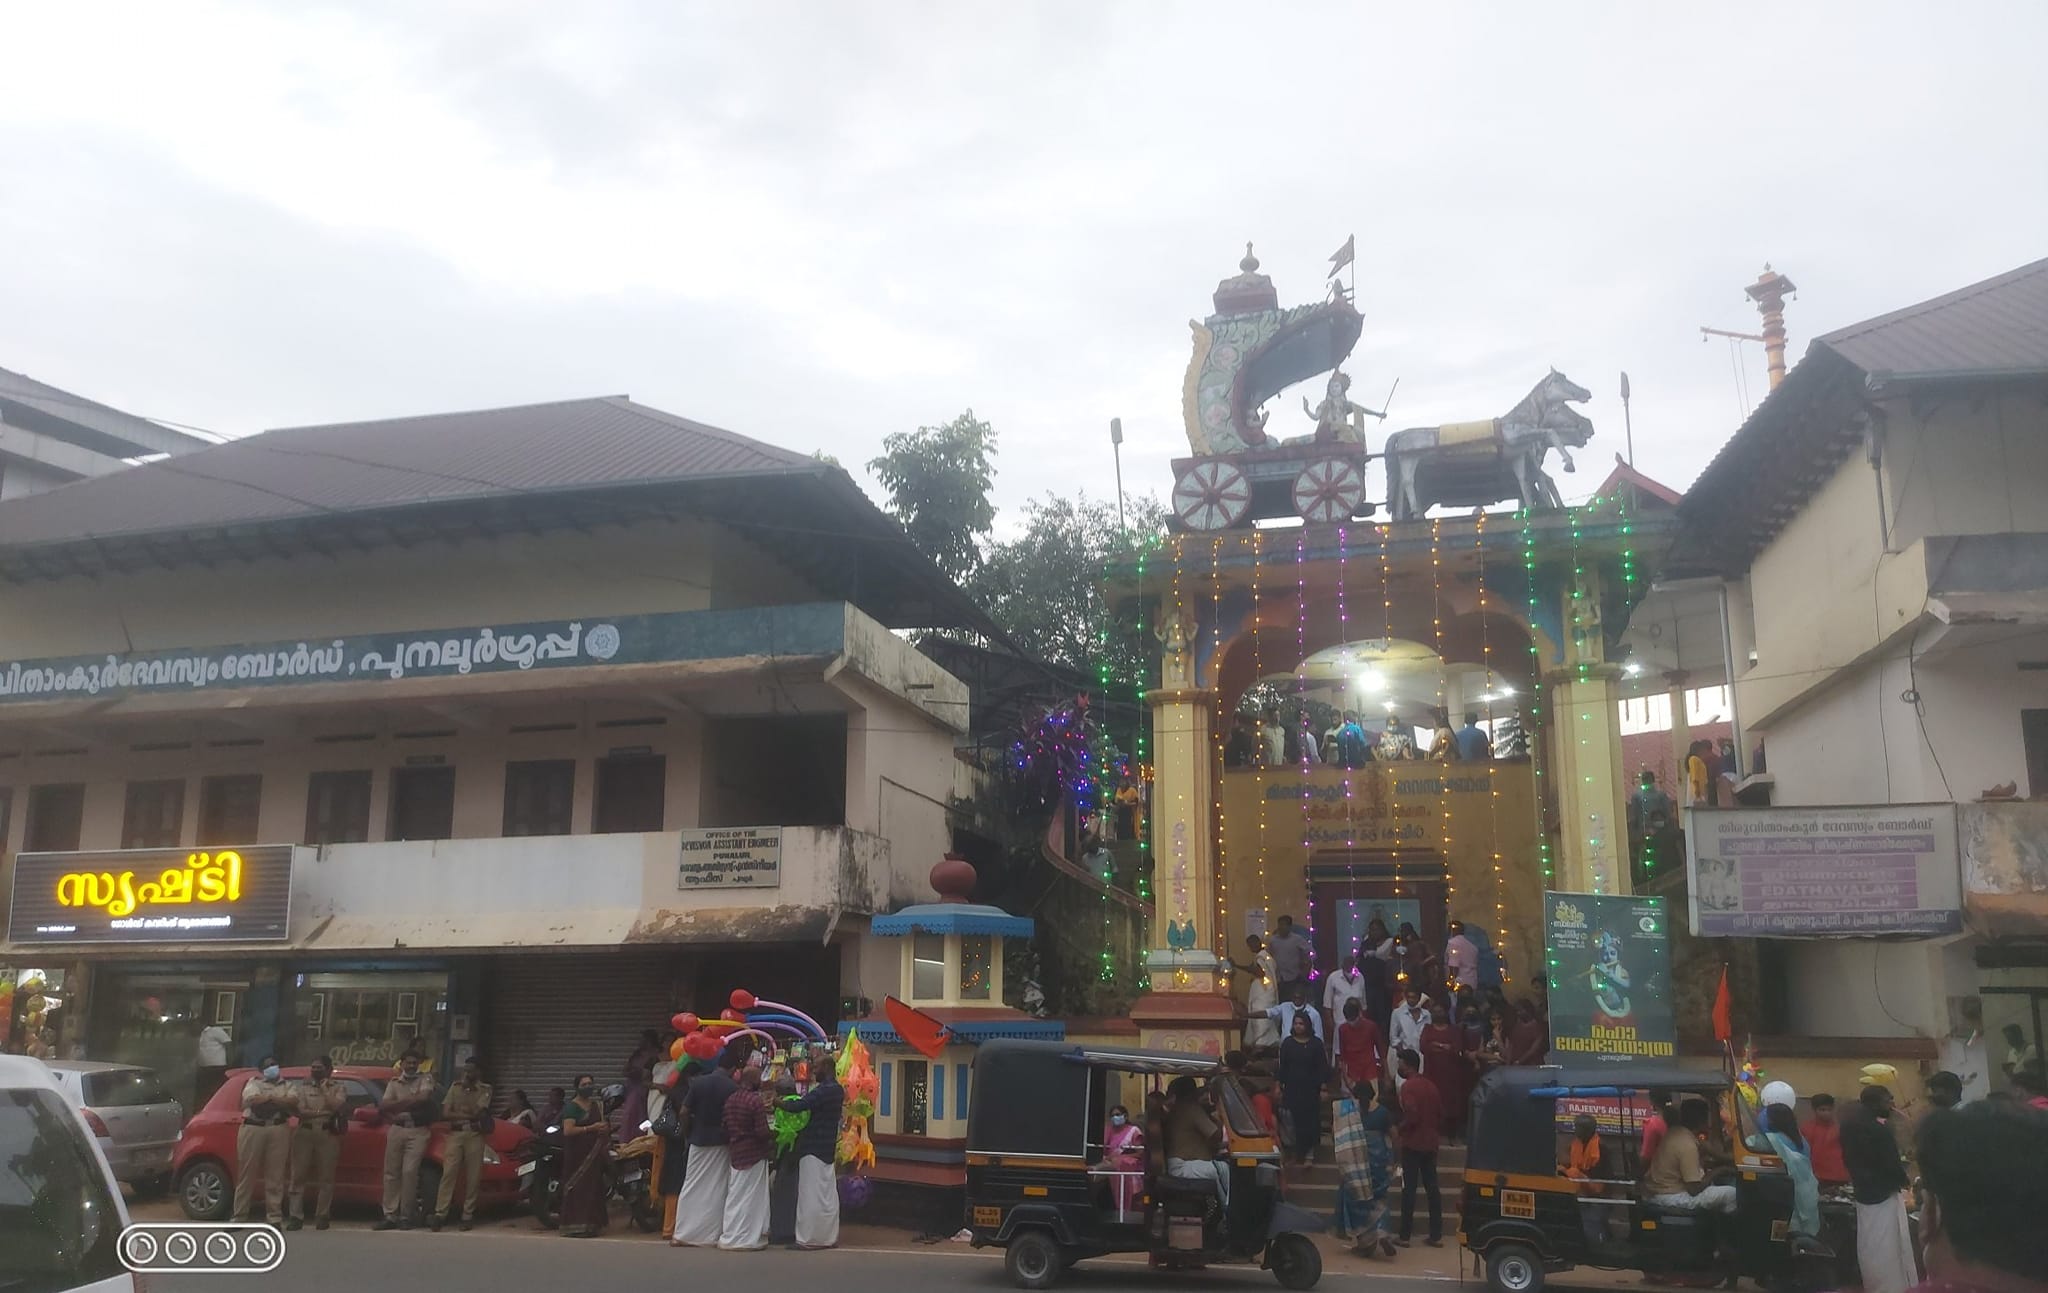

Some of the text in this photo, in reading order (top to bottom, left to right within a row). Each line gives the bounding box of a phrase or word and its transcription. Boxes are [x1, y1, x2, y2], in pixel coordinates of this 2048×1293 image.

[57, 851, 242, 916] സൃഷ്ടി
[1760, 884, 1900, 897] EDATHAVALAM
[1568, 1103, 1607, 1114] RAJEEV'S
[1608, 1106, 1647, 1116] ACADMY
